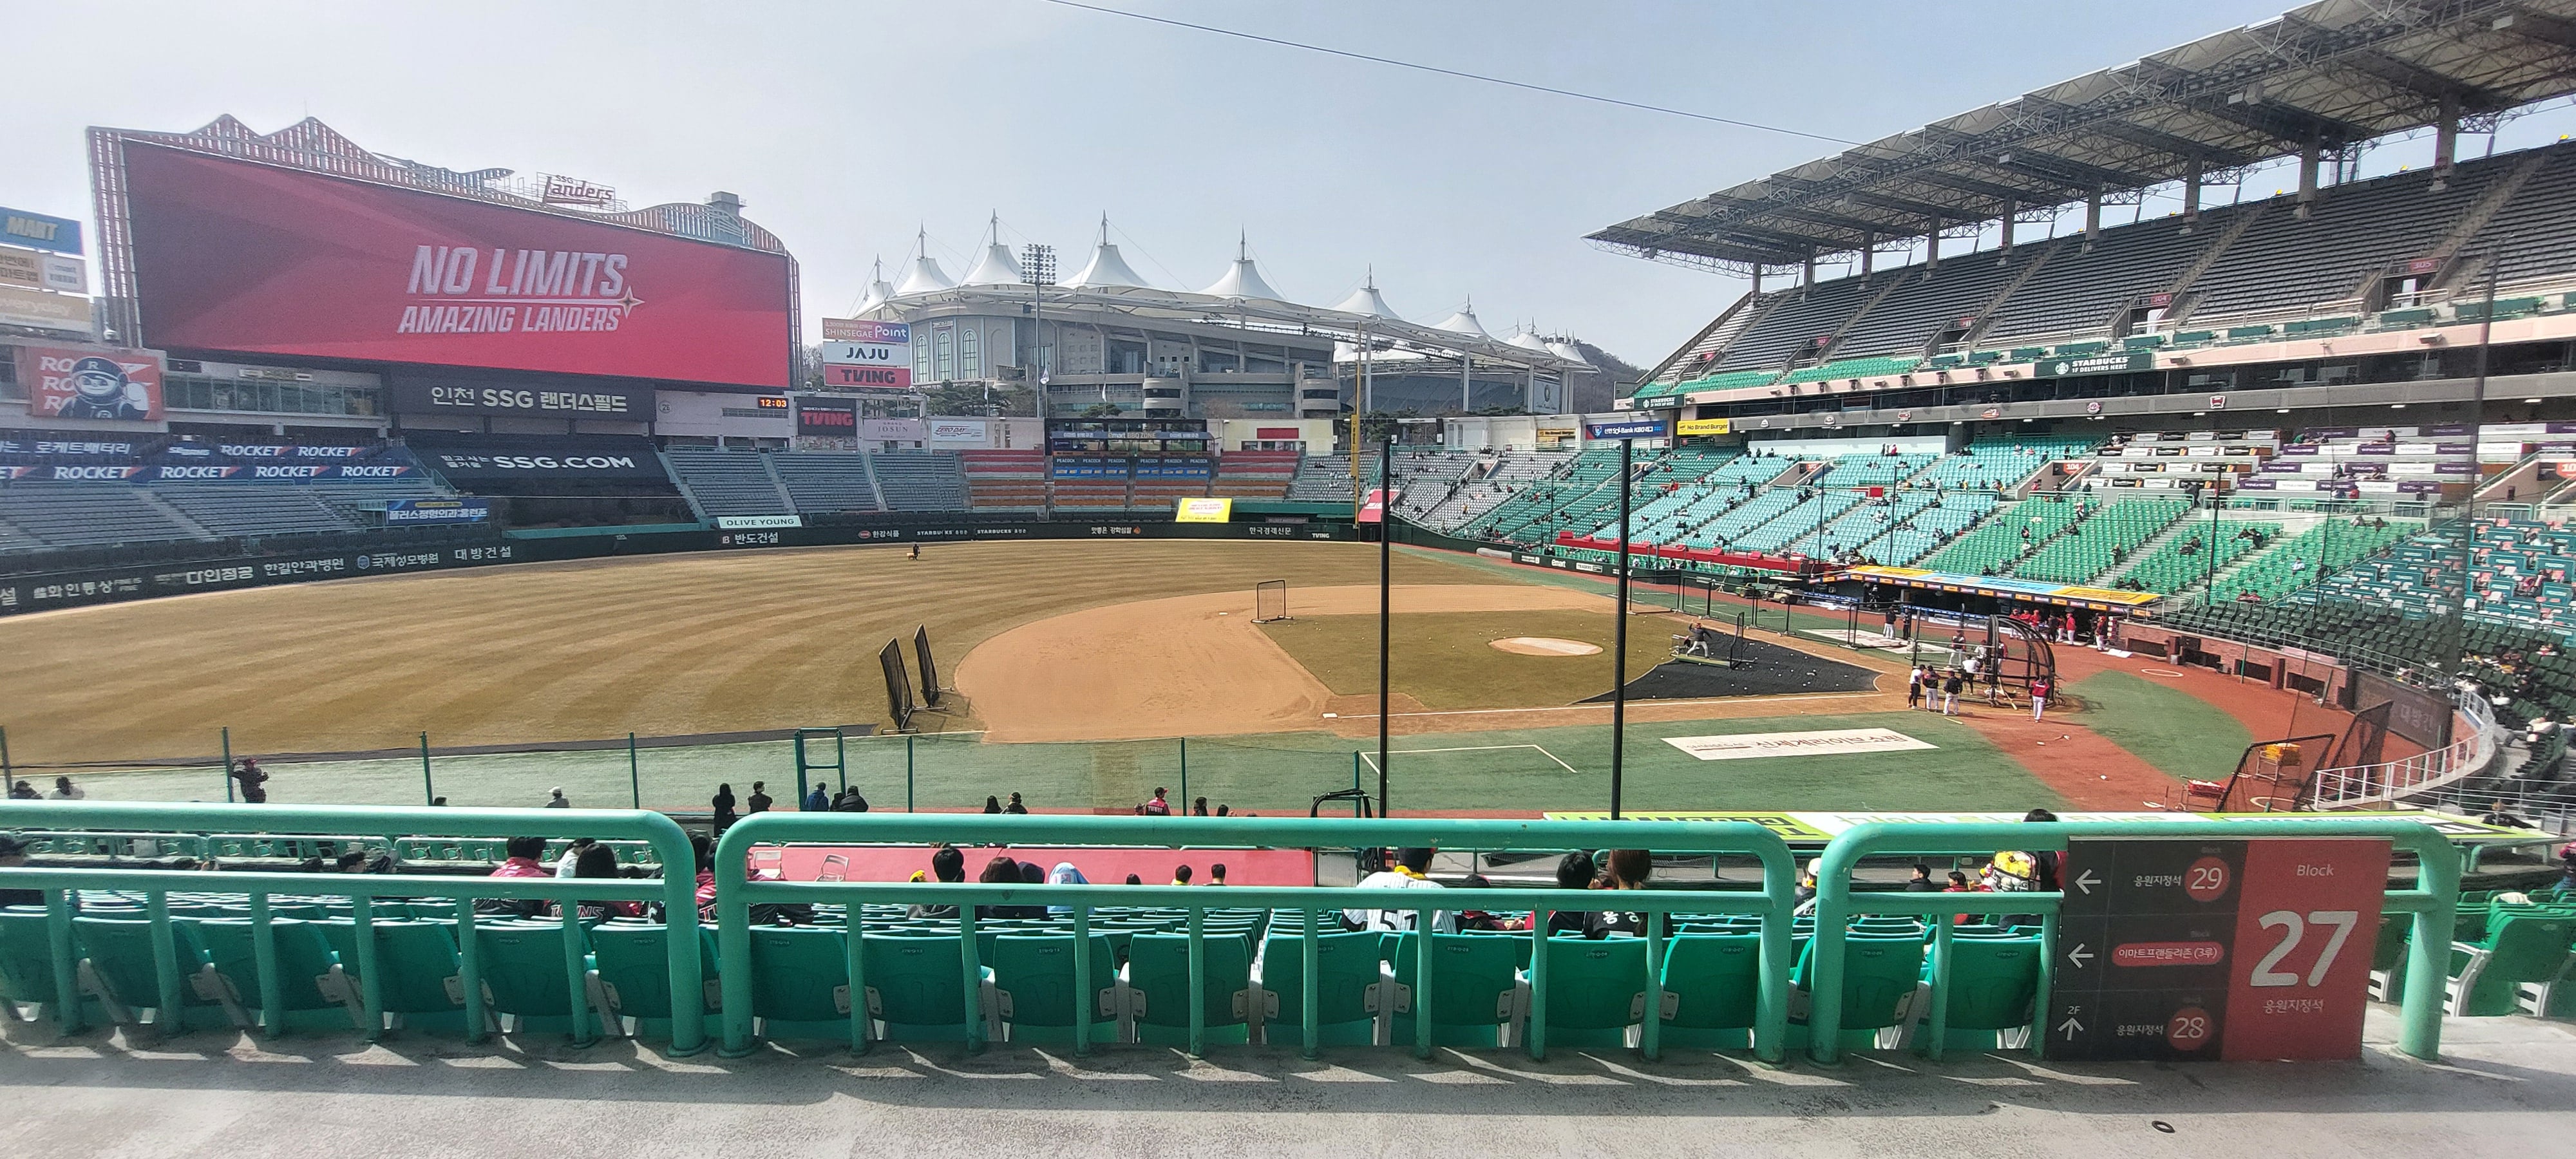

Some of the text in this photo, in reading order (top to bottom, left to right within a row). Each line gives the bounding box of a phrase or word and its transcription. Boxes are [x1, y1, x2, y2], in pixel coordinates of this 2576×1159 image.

[556, 175, 573, 184] SSG
[542, 176, 614, 203] Landers
[7, 216, 58, 241] MART
[406, 245, 628, 296] NO LIMITS
[397, 306, 621, 334] AMAZING LANDERS
[826, 328, 873, 338] SHINSEGAE
[875, 325, 907, 338] Point
[846, 347, 889, 361] JAJU
[2072, 357, 2129, 367] STARBUCKS
[841, 369, 896, 384] TVING
[431, 387, 628, 412] 인천 SSG 랜더스필드
[761, 399, 787, 408] 12:03
[800, 411, 853, 426] TVING
[36, 441, 131, 455] 로케트배터리
[221, 445, 283, 457] ROCKET
[298, 446, 355, 457] ROCKET
[493, 456, 635, 469] SSG.COM
[53, 466, 133, 479] ROCKET
[161, 466, 229, 478] ROCKET
[256, 466, 319, 477] ROCKET
[341, 466, 401, 476] ROCKET
[759, 518, 795, 526] YOUNG
[735, 532, 779, 545] 반도건설
[871, 530, 900, 538] 한강식품
[455, 545, 511, 561] 대방건설
[264, 558, 344, 576] 한길안과병원
[372, 552, 439, 569] 국제성모병원
[1756, 735, 1908, 749] 신세계라이브쇼핑
[2297, 864, 2334, 877] Block
[2134, 867, 2222, 890] 응원지정석 29
[2193, 947, 2218, 960] (3루)
[2249, 910, 2358, 988] 27
[2068, 1006, 2081, 1015] 2F
[2263, 999, 2324, 1013] 응원지정석
[2116, 1017, 2205, 1039] 응원지정석 28
